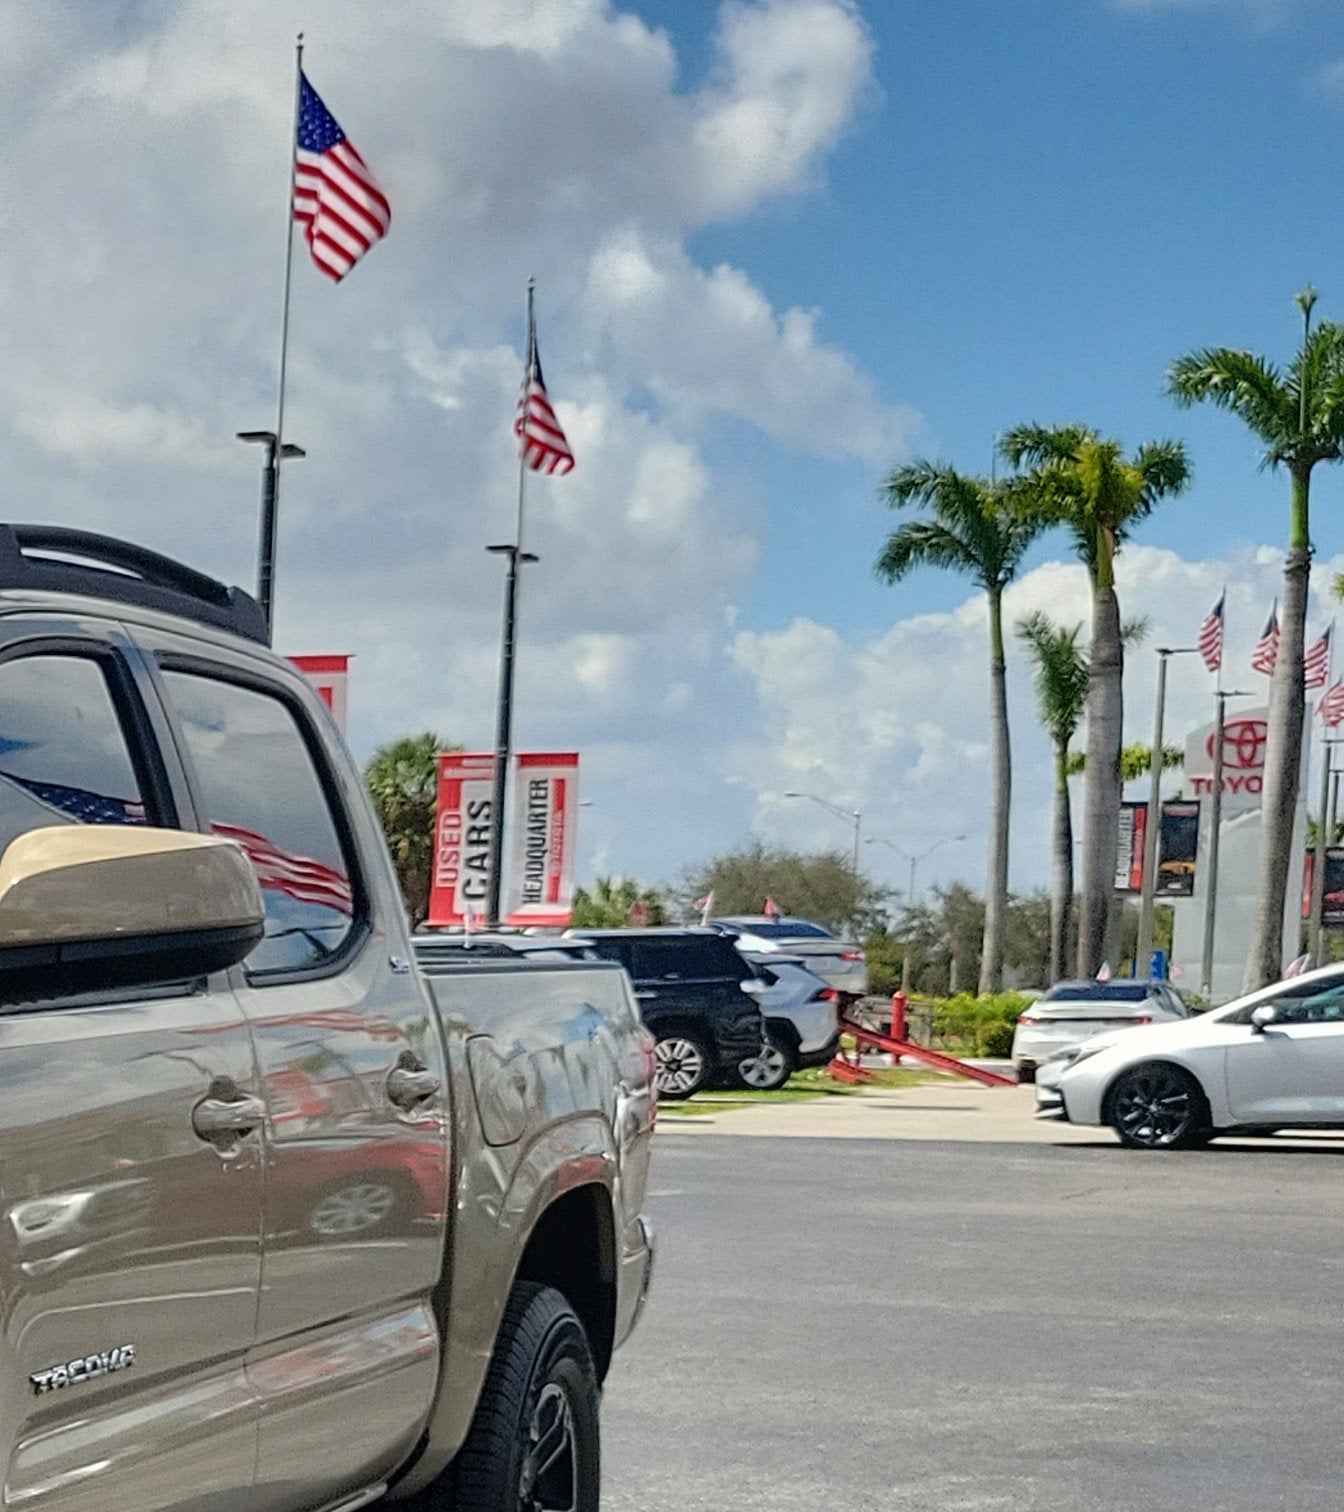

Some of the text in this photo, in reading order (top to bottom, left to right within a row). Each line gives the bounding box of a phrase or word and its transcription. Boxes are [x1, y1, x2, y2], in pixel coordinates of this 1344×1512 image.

[1190, 775, 1263, 795] TOYO
[438, 811, 461, 887] USED
[462, 800, 493, 900] CARS
[520, 778, 549, 905] HEADQUARTER
[29, 1344, 135, 1395] TACOMA
